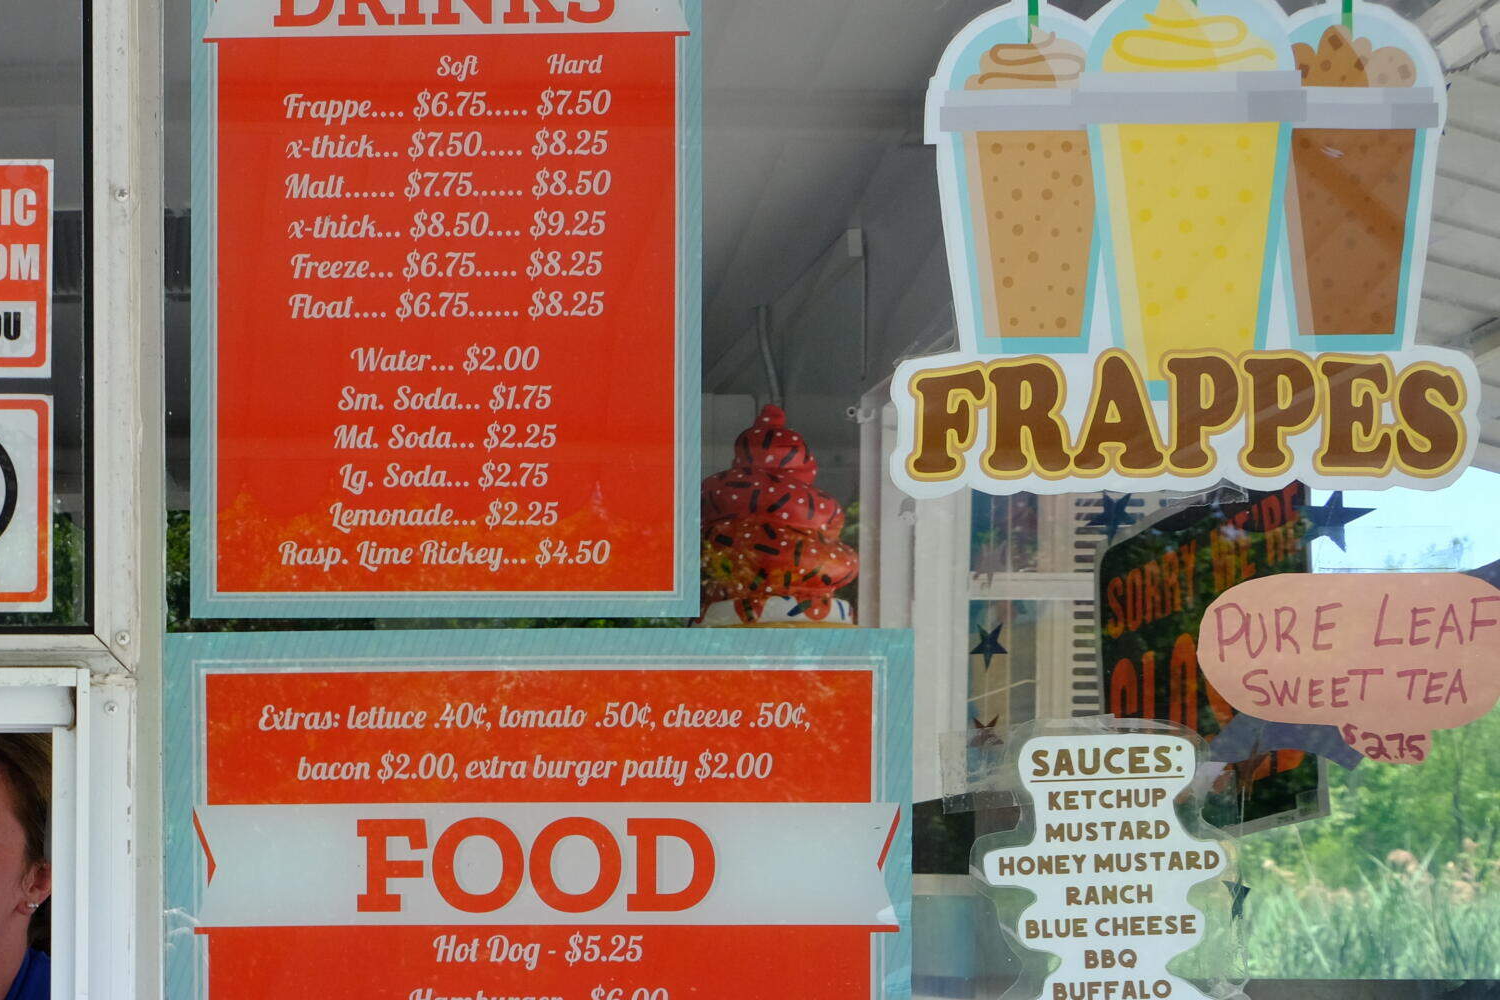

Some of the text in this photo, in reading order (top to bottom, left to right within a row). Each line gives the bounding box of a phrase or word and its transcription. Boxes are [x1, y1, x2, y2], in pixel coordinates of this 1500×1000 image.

[436, 52, 603, 81] Soft Hard
[536, 88, 612, 118] $7.50
[532, 130, 608, 158] $8.25
[462, 345, 540, 372] $2.00
[338, 384, 552, 412] Sm. $1.75
[907, 353, 1467, 483] FRAPPES
[333, 423, 556, 450] Md. $2.25
[340, 462, 548, 492] Lg. $2.75
[485, 502, 558, 528] $2.25
[278, 540, 610, 571] Rasp. Lime $4.50
[1214, 594, 1500, 661] PURE LEAF
[1242, 668, 1468, 708] SWEET TEA
[258, 701, 811, 731] Extras: lettuce .40¢, tomato .50¢, cheese .50¢,
[1031, 744, 1182, 777] SAUCES:
[1047, 788, 1167, 811] KETCHUP
[1045, 820, 1171, 843] MUSTARD
[357, 816, 716, 913] FOOD
[998, 851, 1220, 877] HONEY MUSTARD
[1066, 884, 1153, 906] RANCH
[1025, 915, 1196, 939] BLUE CHEESE
[433, 934, 643, 970] Hot Dog $5.25
[1084, 949, 1138, 970] BBQ
